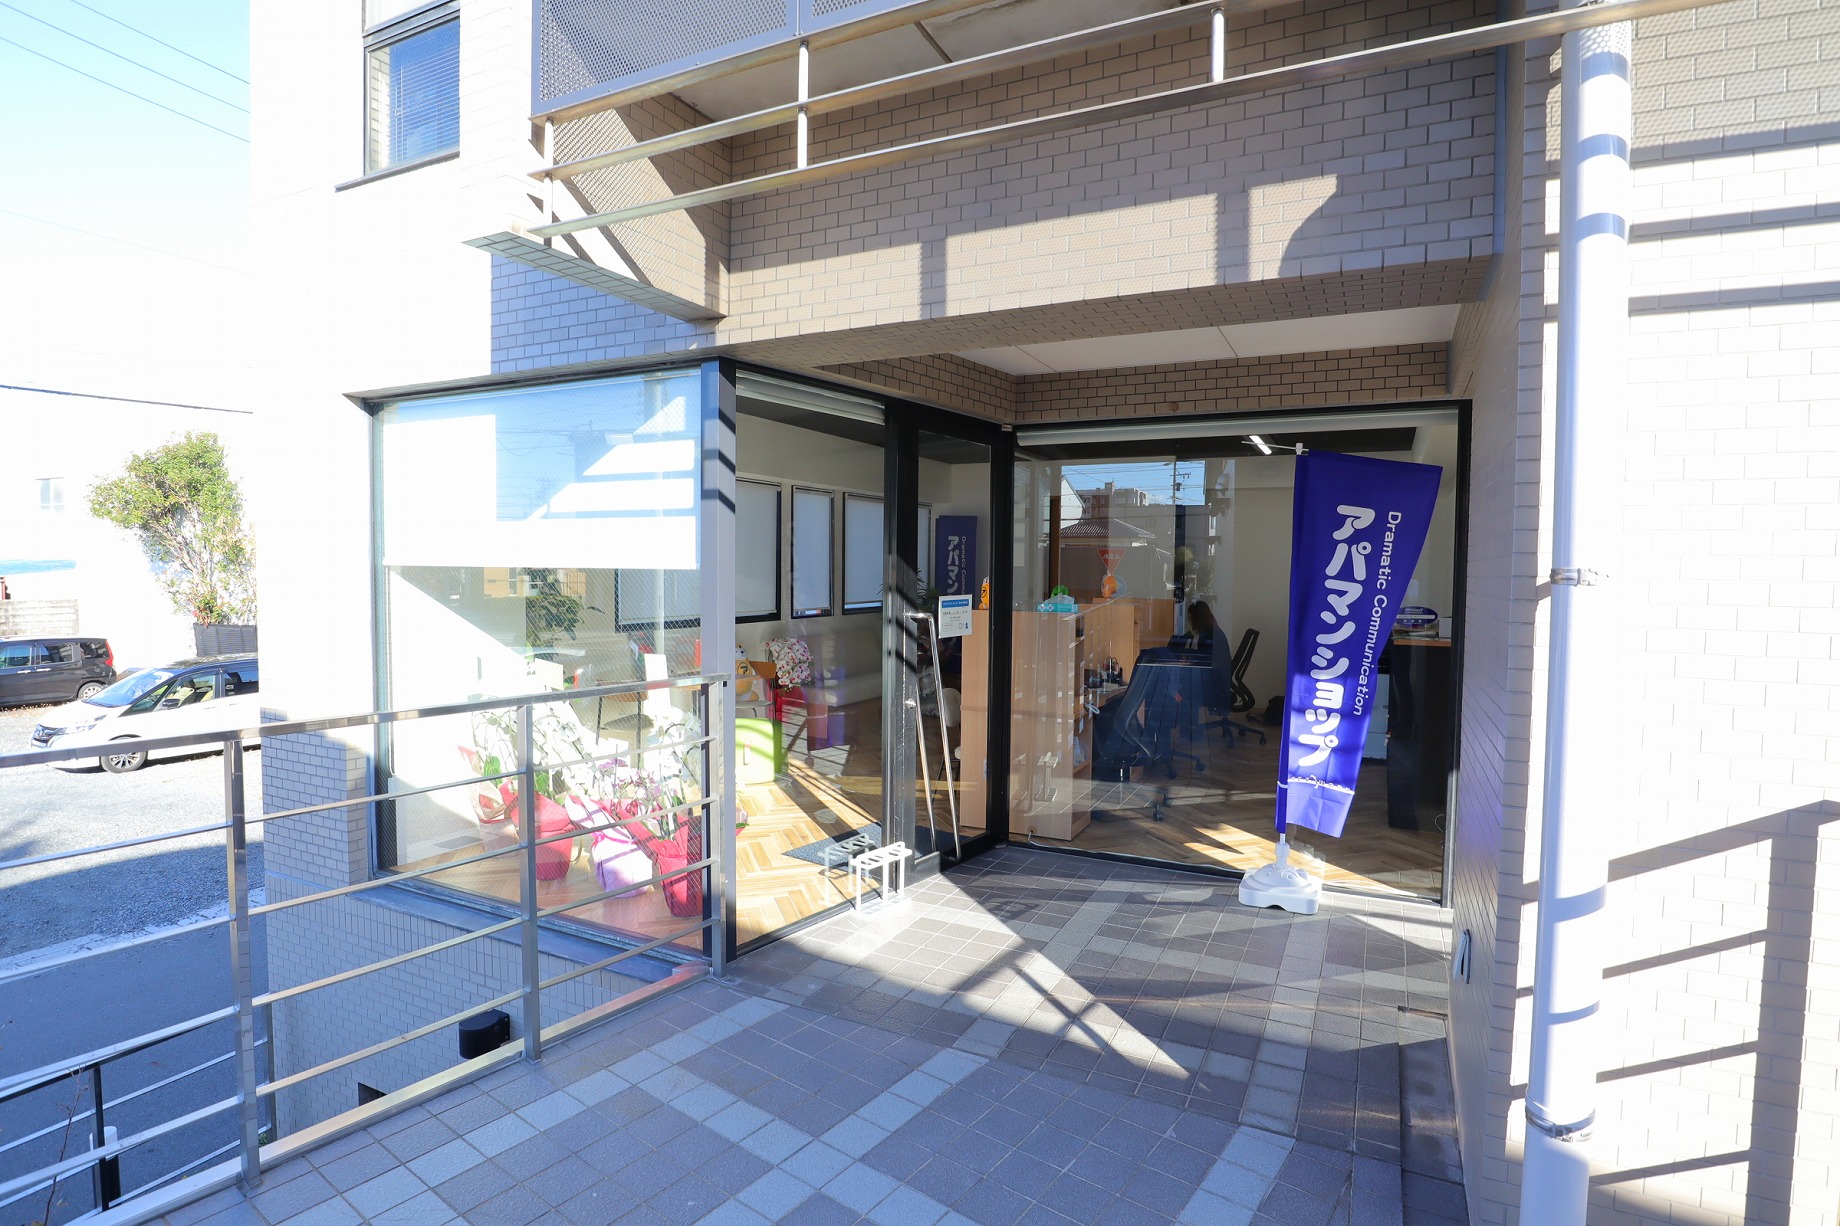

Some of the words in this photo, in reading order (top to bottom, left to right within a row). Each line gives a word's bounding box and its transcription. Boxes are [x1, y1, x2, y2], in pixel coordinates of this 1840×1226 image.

[947, 535, 960, 595] アパマン
[1376, 511, 1401, 590] Dramatic
[1298, 504, 1375, 767] アパマンショップ
[1353, 594, 1388, 716] Communication
